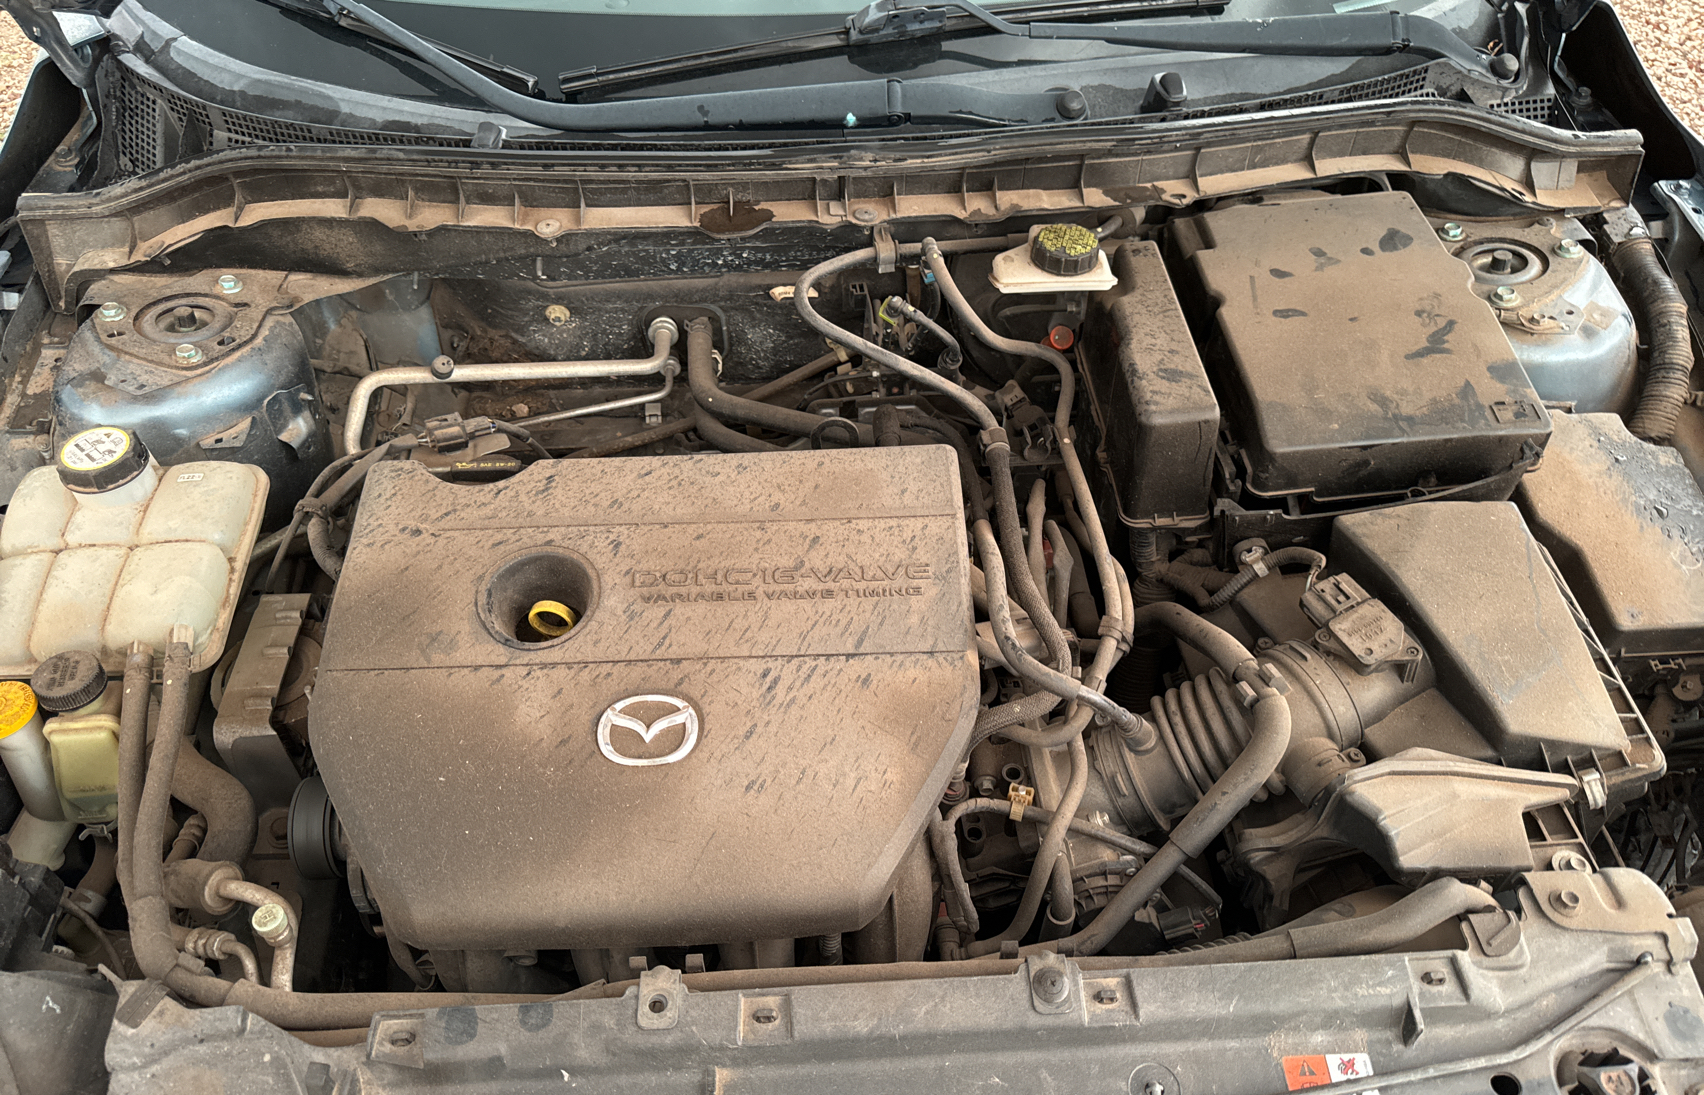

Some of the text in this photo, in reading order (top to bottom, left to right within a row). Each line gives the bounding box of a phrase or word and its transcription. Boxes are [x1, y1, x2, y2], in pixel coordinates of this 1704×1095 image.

[632, 563, 932, 587] DOHC 16-VALVE
[640, 586, 924, 604] VARIABLE VALVE TIMING
